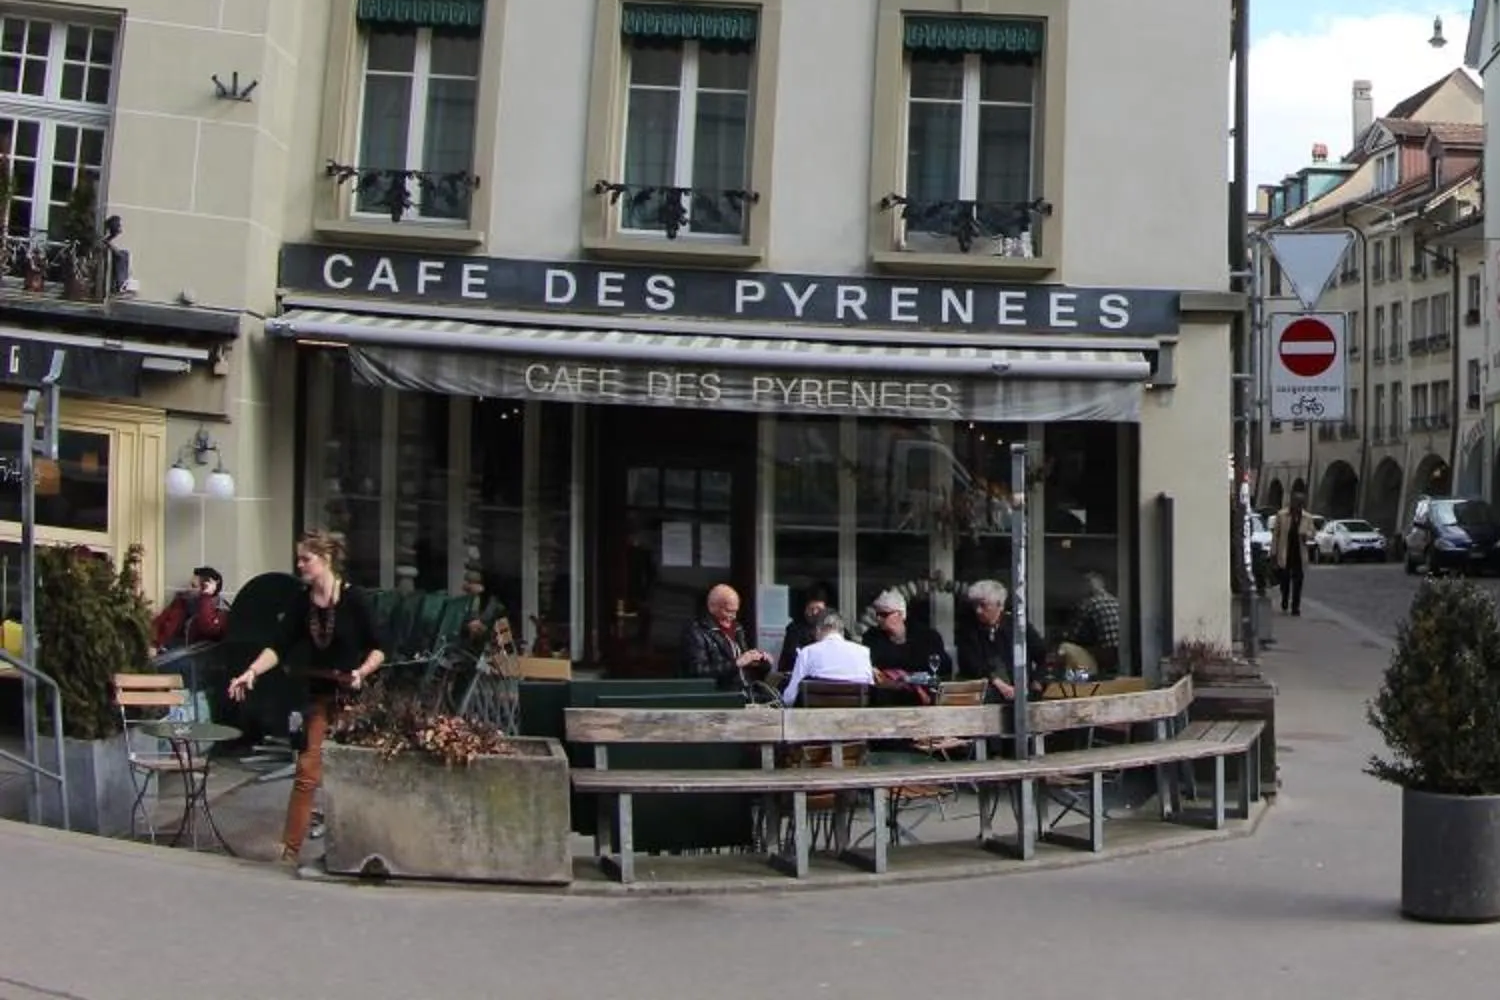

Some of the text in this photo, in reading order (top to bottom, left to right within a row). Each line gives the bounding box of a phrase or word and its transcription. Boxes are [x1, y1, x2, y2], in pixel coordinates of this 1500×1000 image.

[322, 253, 1131, 329] CAFE DES PYRENEES
[525, 364, 955, 412] CAFE DES PYRENEES
